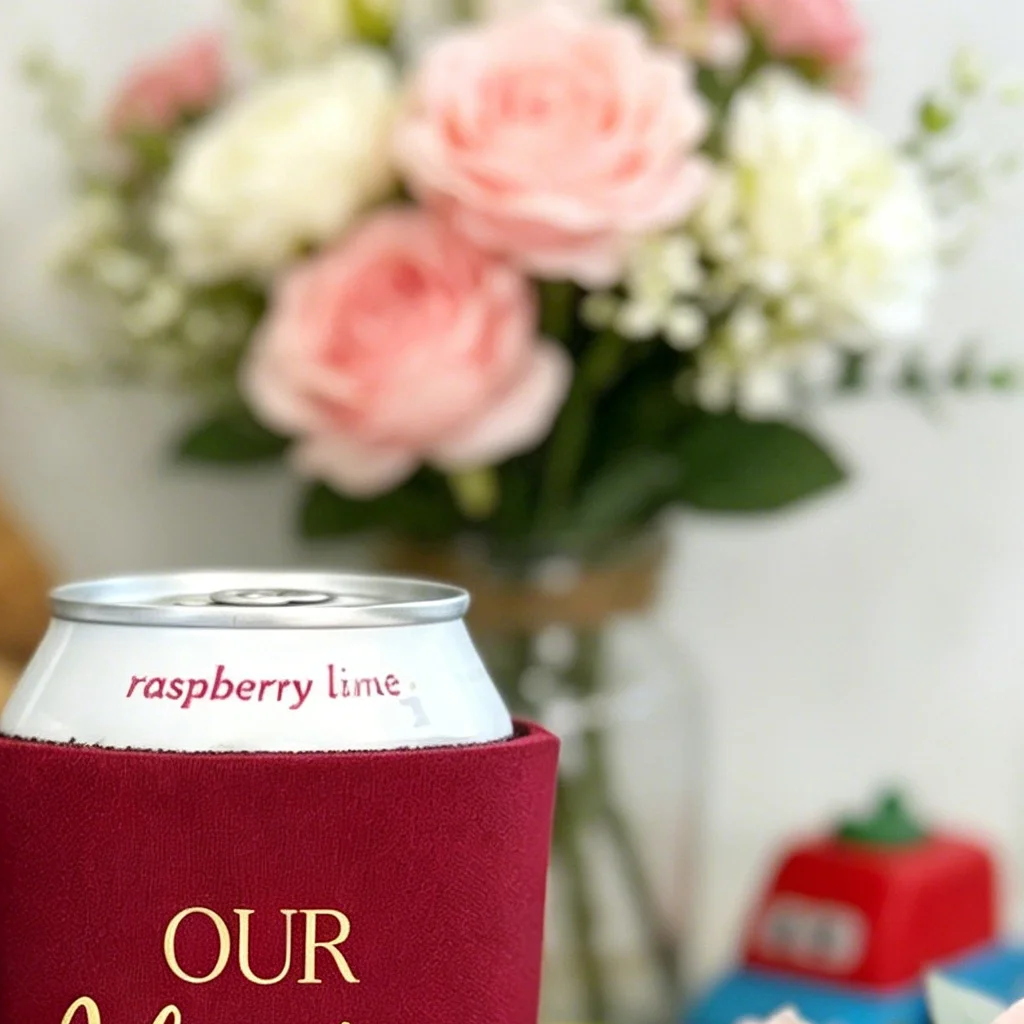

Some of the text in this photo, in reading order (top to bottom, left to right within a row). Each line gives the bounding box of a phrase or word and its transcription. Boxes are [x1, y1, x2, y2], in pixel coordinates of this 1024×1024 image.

[126, 663, 400, 710] raspberry lime
[163, 906, 360, 985] OUR
